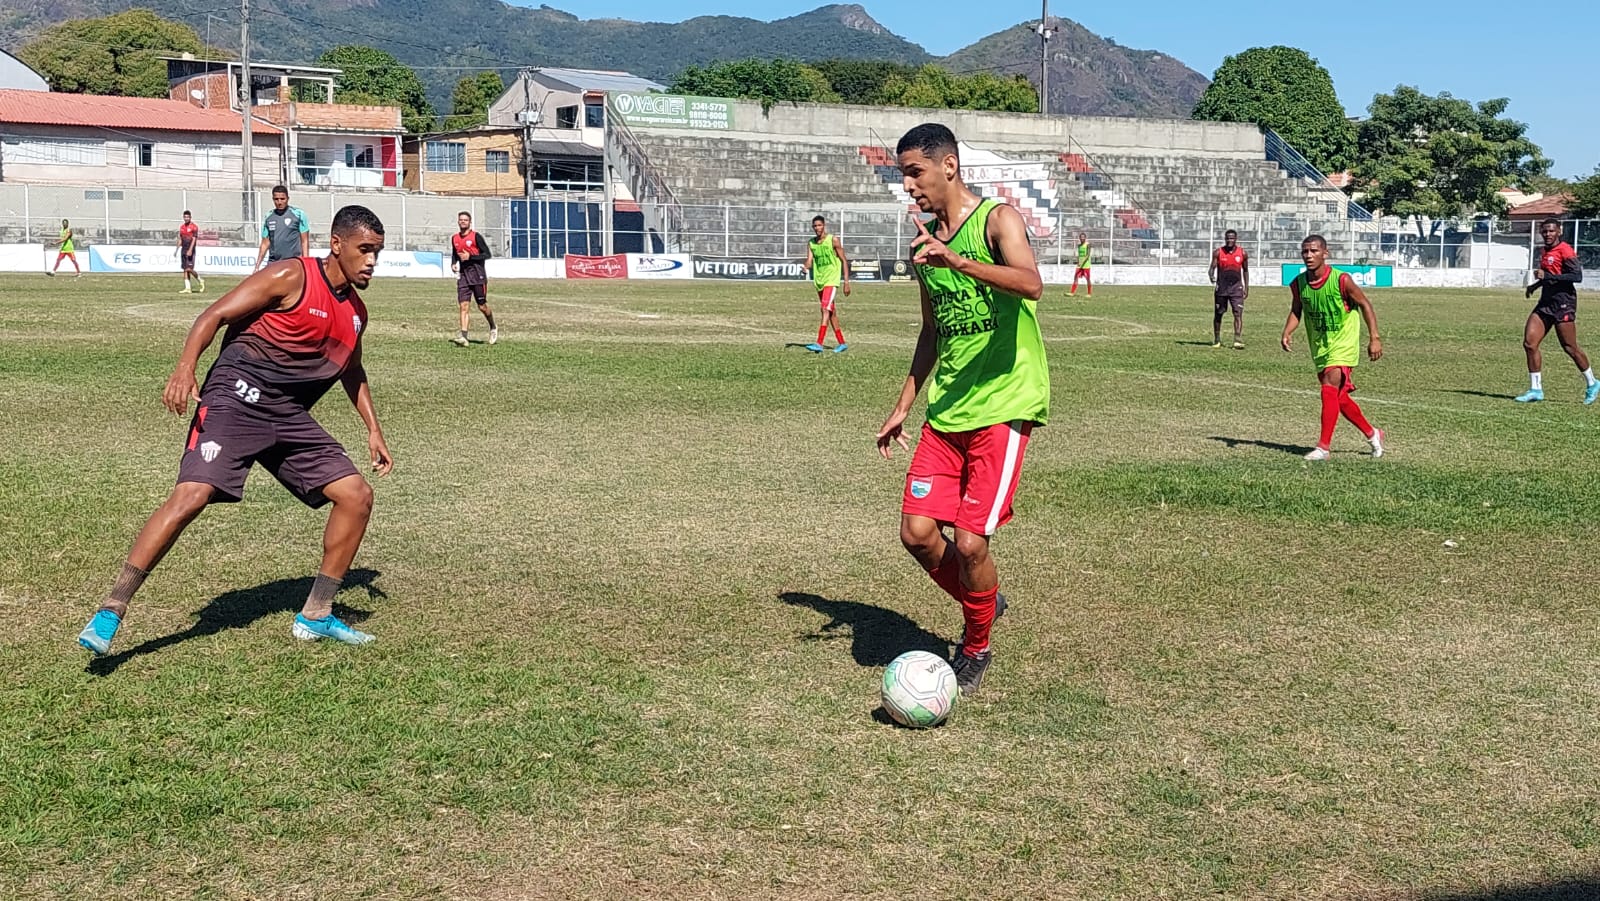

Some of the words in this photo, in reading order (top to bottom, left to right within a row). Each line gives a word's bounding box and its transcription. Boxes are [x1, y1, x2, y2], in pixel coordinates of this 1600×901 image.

[114, 253, 142, 264] FES
[695, 260, 748, 274] VETTOR
[235, 378, 261, 404] 28
